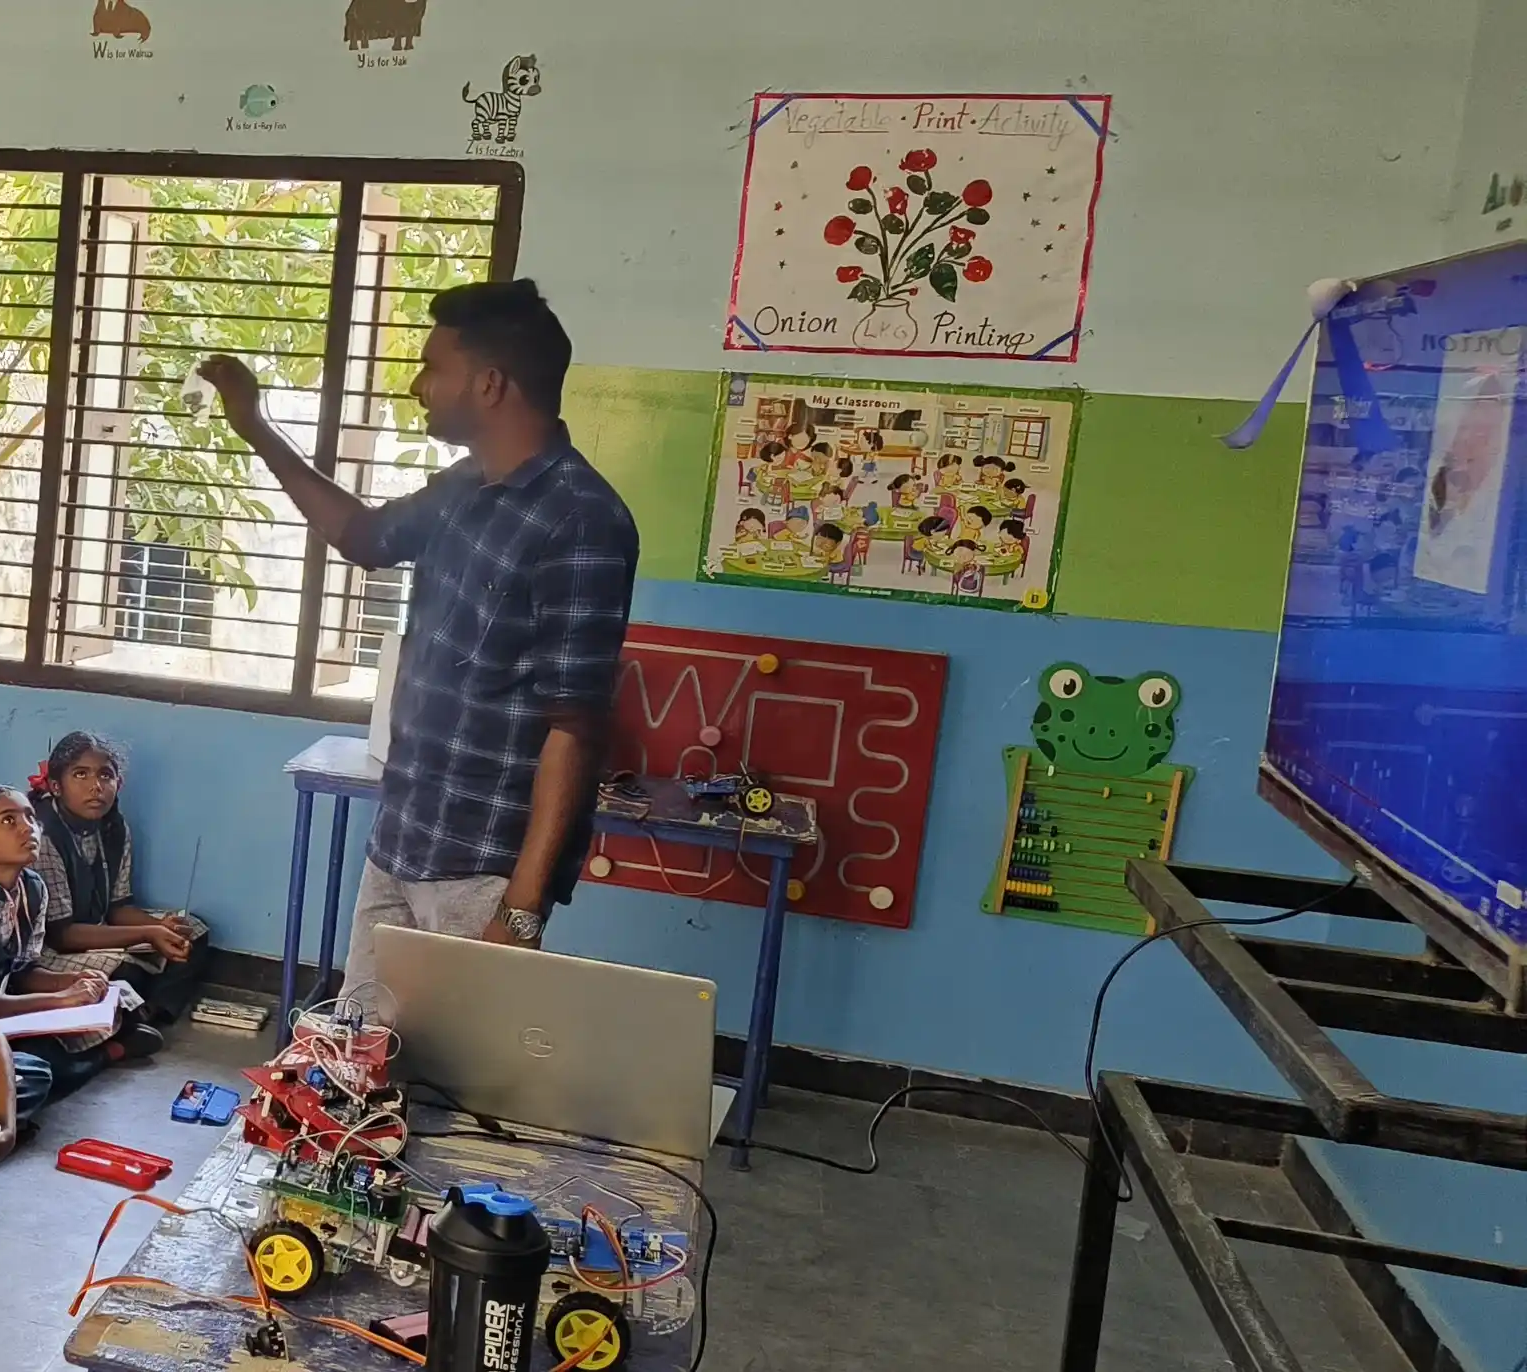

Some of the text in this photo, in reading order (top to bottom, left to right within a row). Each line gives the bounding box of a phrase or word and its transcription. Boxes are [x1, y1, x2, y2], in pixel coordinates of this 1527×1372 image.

[93, 41, 108, 58] W
[115, 49, 126, 58] for
[367, 57, 374, 67] is
[377, 56, 389, 66] for
[226, 116, 233, 131] X
[913, 102, 970, 130] Print
[978, 103, 1073, 151] Activity
[466, 138, 474, 154] Z
[485, 145, 498, 156] for
[754, 306, 838, 335] Onion
[930, 310, 1035, 354] Printing
[813, 395, 901, 409] My Classroom
[483, 1300, 507, 1369] SPIDER
[502, 1304, 516, 1370] BOTTLE
[509, 1303, 525, 1372] FESSIONAL
